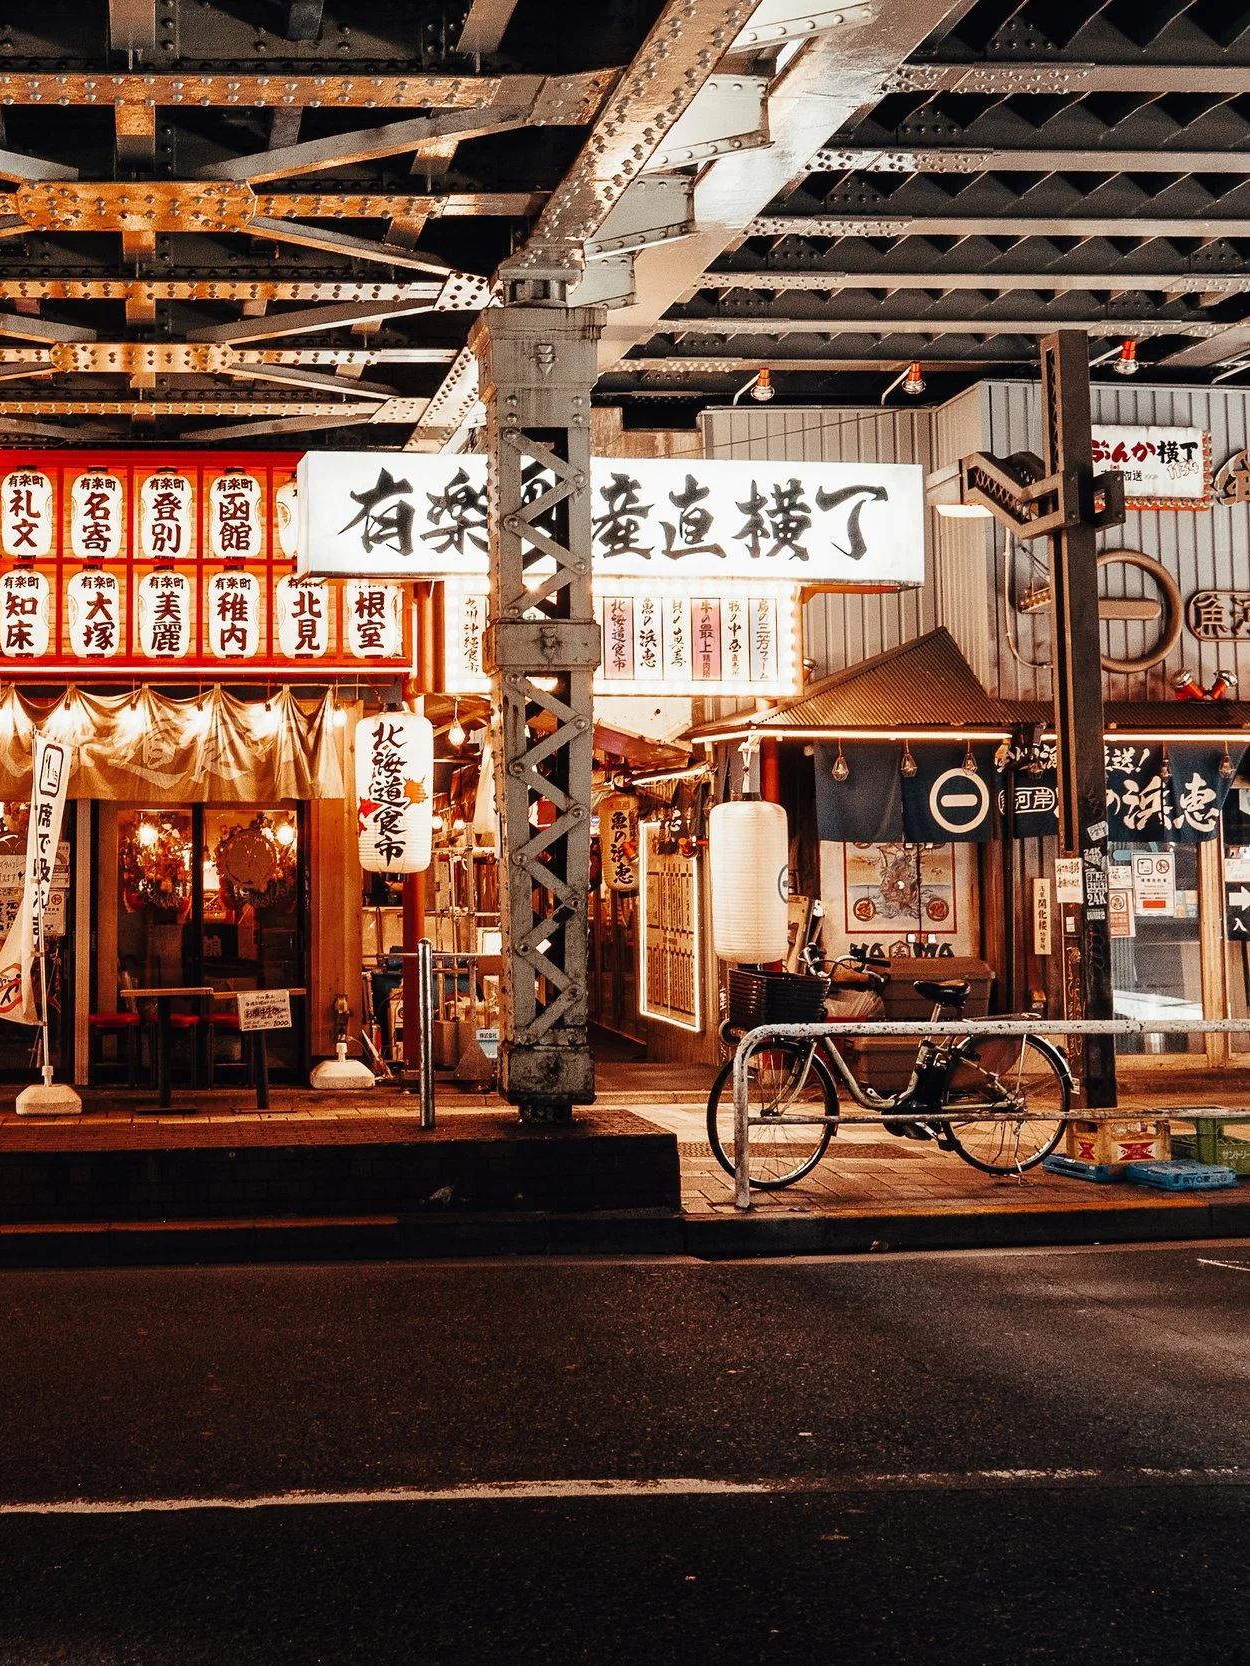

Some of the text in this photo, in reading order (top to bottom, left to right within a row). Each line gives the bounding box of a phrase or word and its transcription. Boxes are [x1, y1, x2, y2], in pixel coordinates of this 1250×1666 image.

[8, 474, 44, 489] 有楽町
[80, 477, 116, 492] 有楽町
[149, 477, 185, 492] 有楽町
[216, 477, 253, 492] 有楽町
[9, 489, 41, 548] 礼文
[81, 492, 112, 552] 名寄
[152, 493, 181, 552] 登別
[219, 493, 251, 551] 函館
[4, 576, 40, 590] 有楽町
[80, 576, 116, 590] 有楽町
[149, 576, 185, 591] 有楽町
[214, 577, 252, 591] 有楽町
[5, 591, 39, 650] 知床
[217, 591, 249, 651] 稚内
[291, 591, 322, 651] 北見
[354, 591, 387, 649] 根室
[611, 599, 627, 672] 北海道食市
[371, 722, 408, 866] 北海道食市
